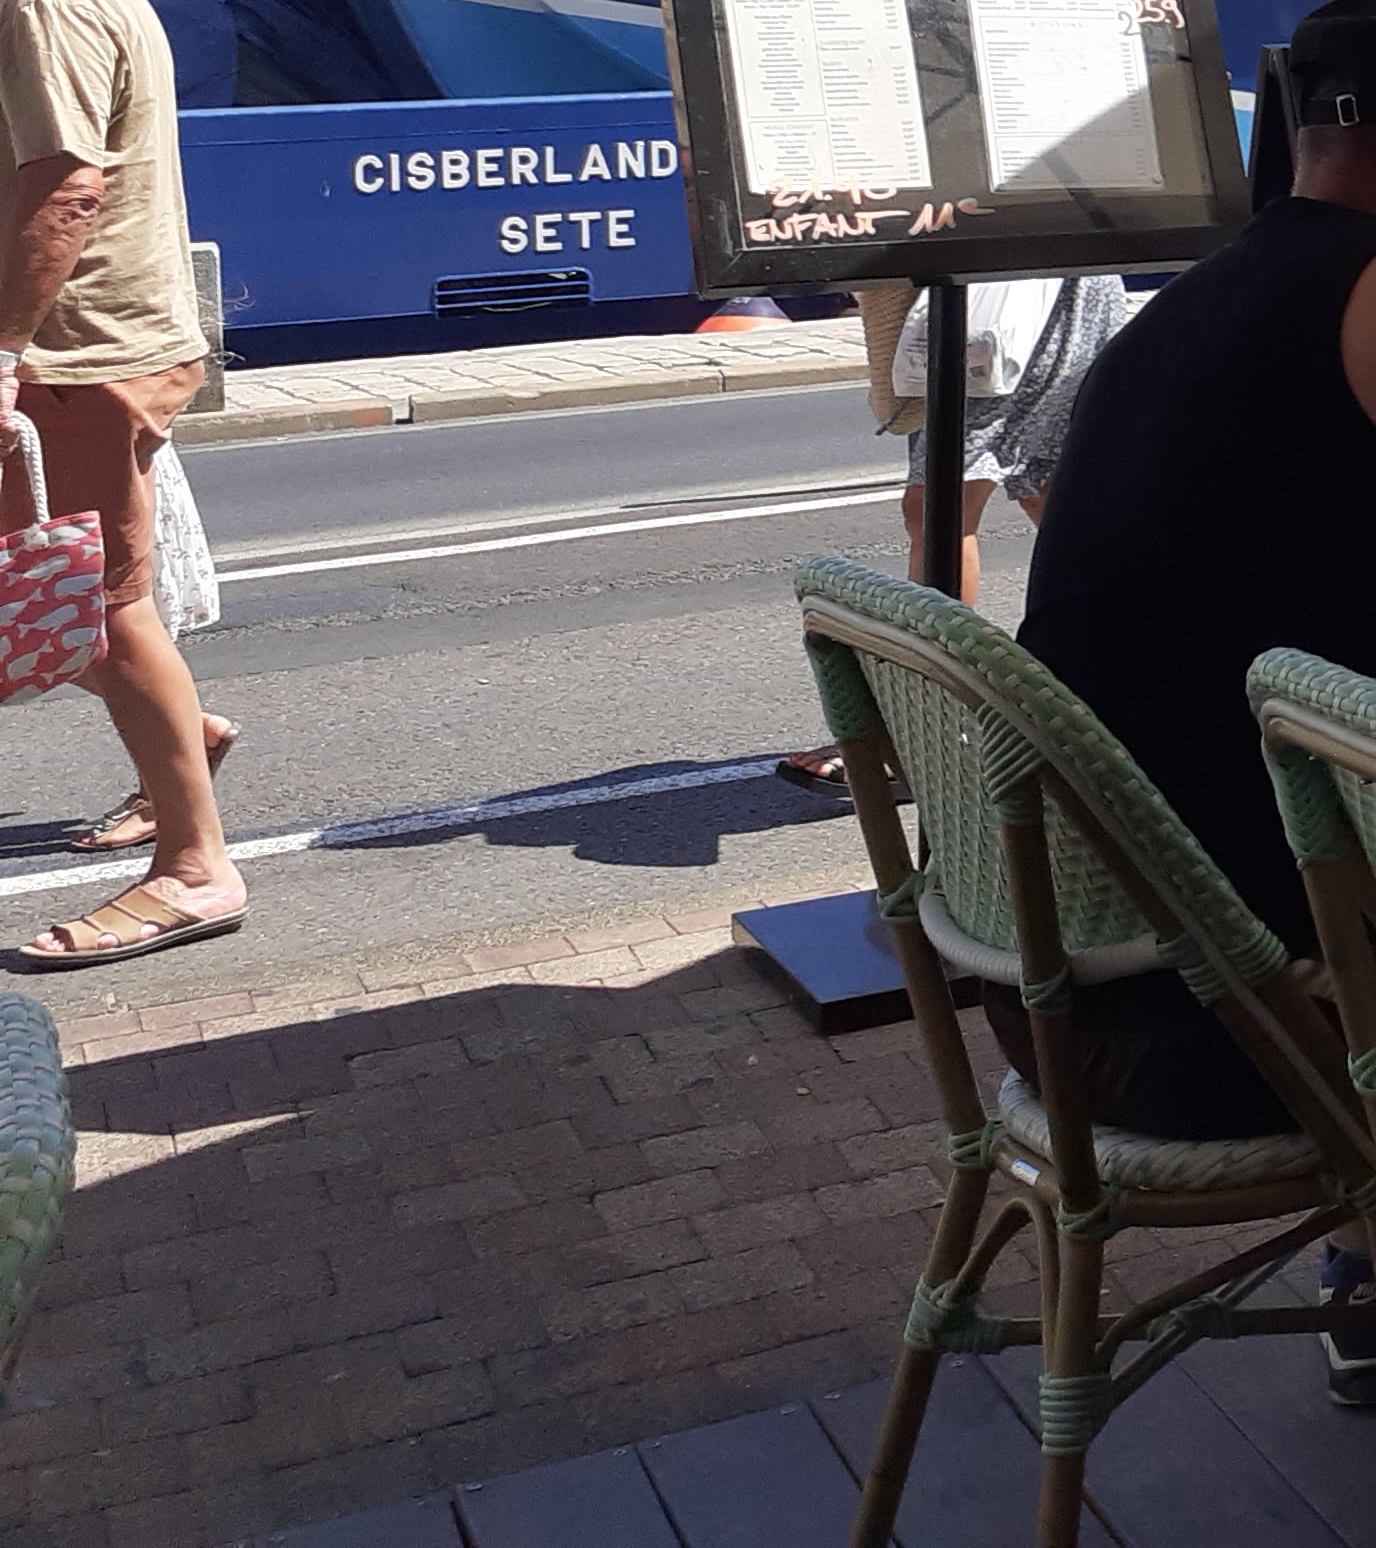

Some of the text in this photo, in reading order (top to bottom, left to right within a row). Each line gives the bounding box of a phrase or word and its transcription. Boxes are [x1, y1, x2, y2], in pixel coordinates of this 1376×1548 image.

[353, 139, 679, 195] CISBERLAND
[500, 209, 637, 254] SETE
[744, 209, 911, 243] ENFANT
